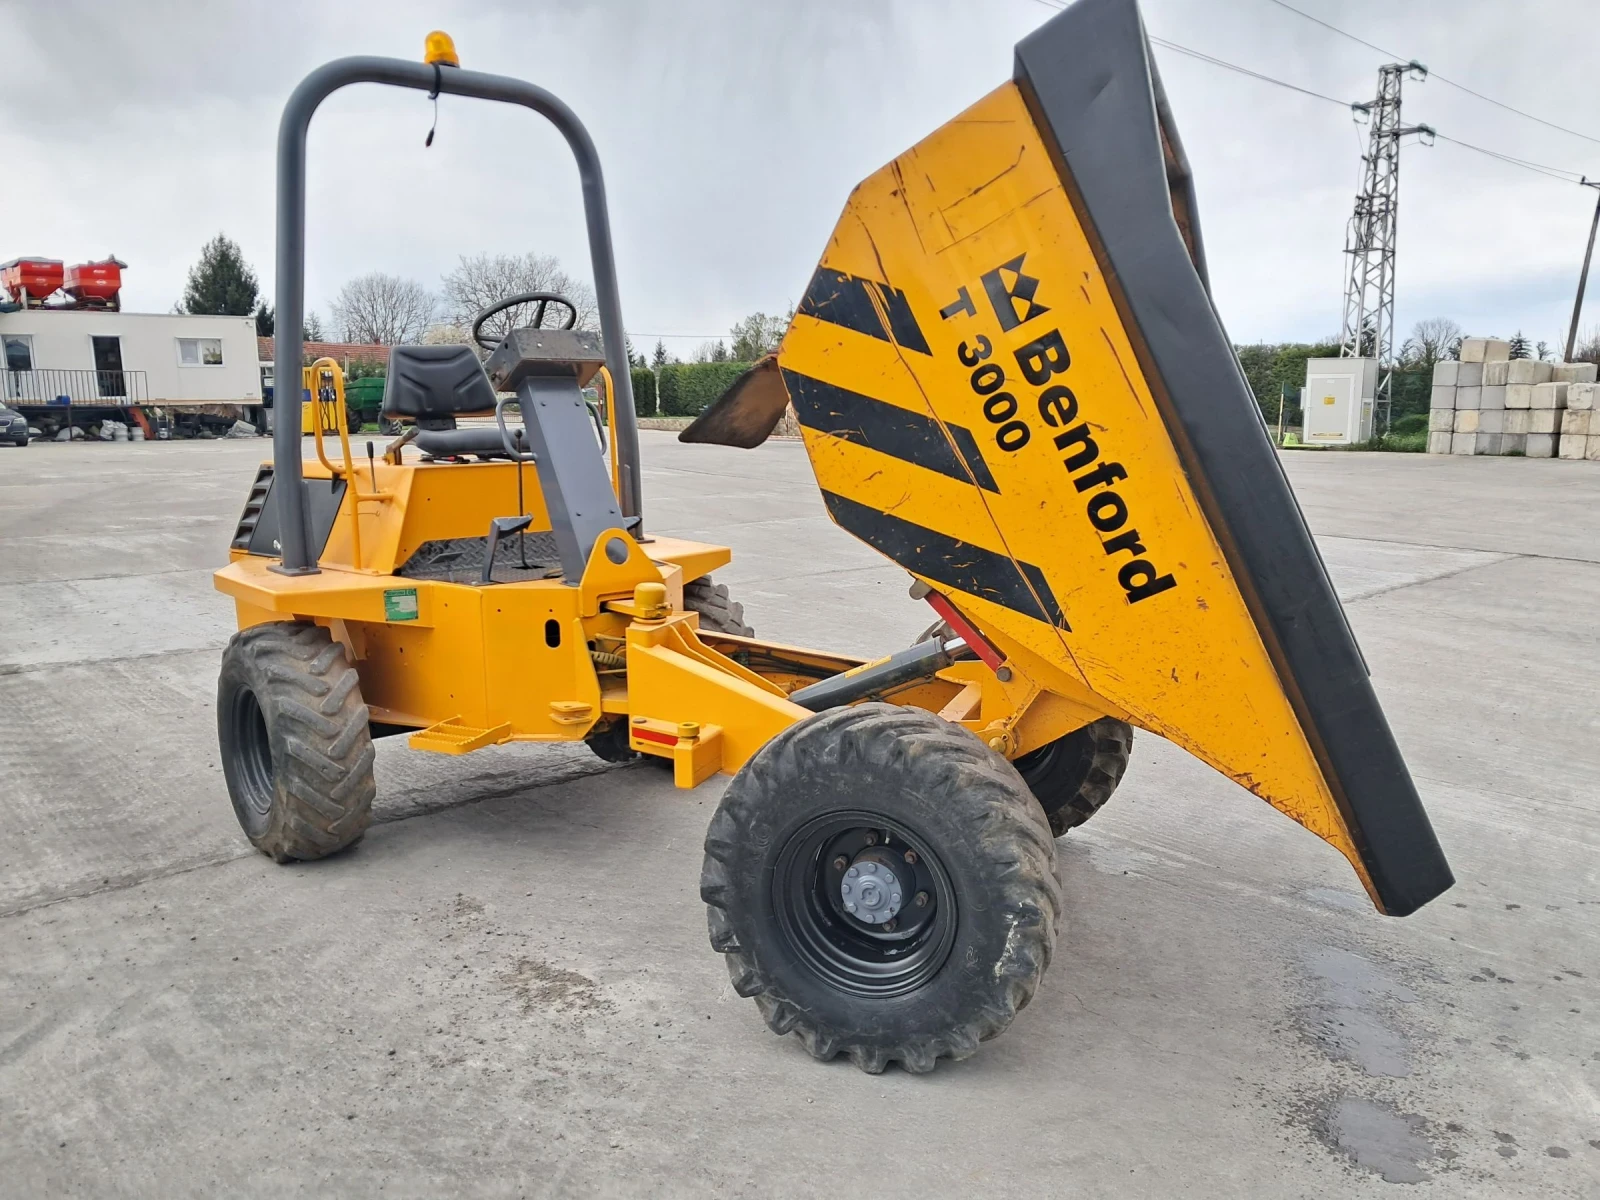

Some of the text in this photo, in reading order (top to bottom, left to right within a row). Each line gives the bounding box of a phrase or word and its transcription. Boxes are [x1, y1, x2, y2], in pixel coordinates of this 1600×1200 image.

[939, 286, 1031, 452] T 3000
[1013, 329, 1178, 604] Benford
